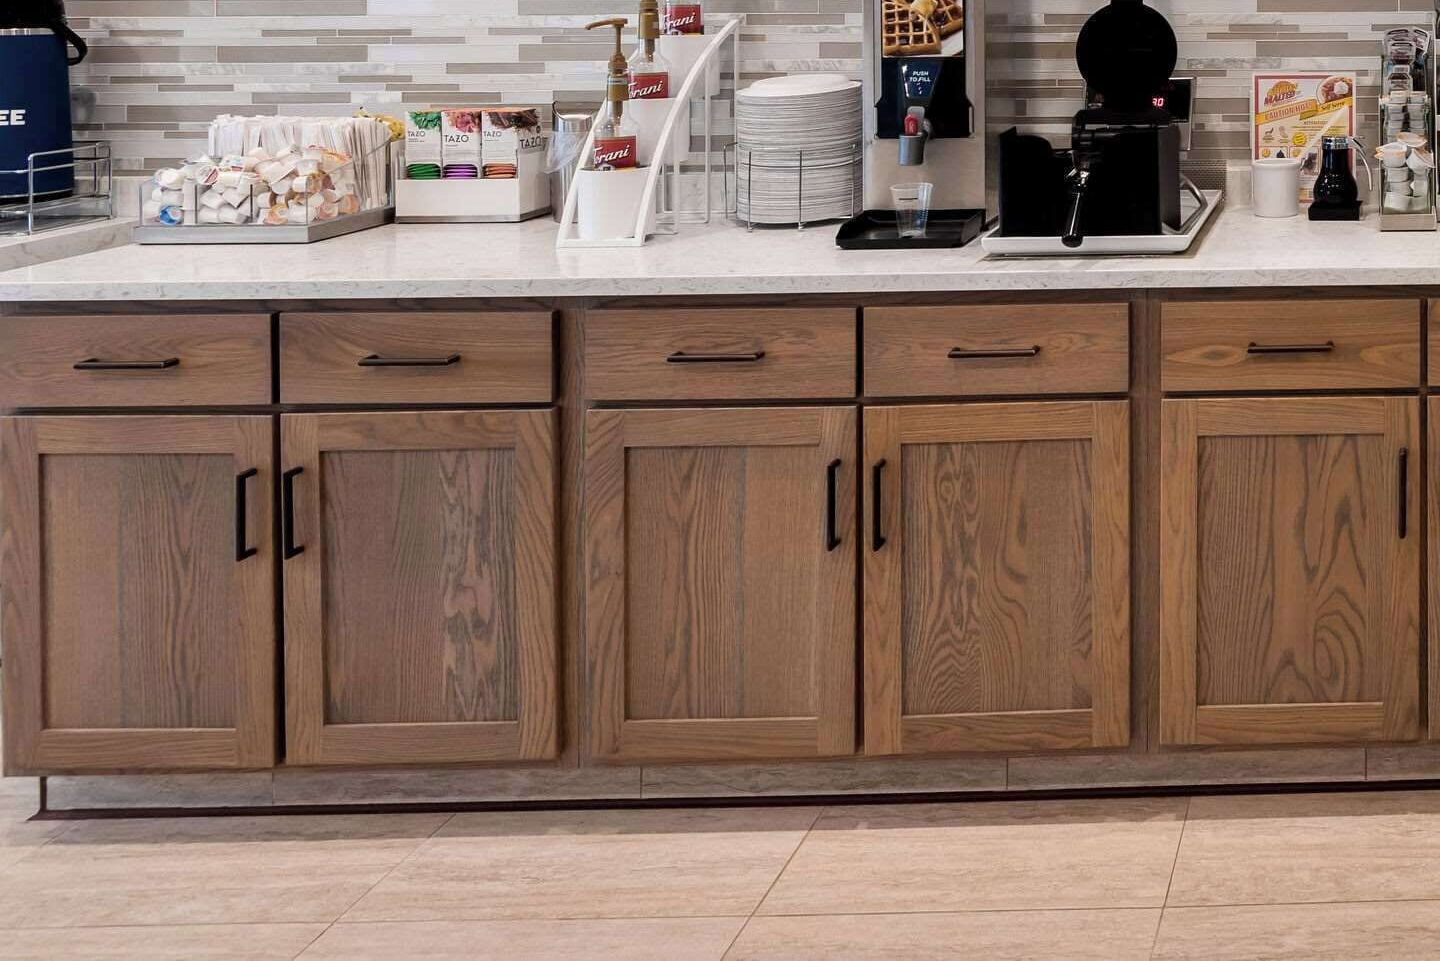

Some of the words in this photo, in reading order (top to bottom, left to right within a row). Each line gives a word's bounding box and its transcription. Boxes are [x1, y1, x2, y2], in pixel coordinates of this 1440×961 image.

[407, 130, 426, 138] TAZO
[483, 130, 503, 138] TAZO
[443, 134, 470, 143] TAZO
[519, 137, 543, 149] TAZO
